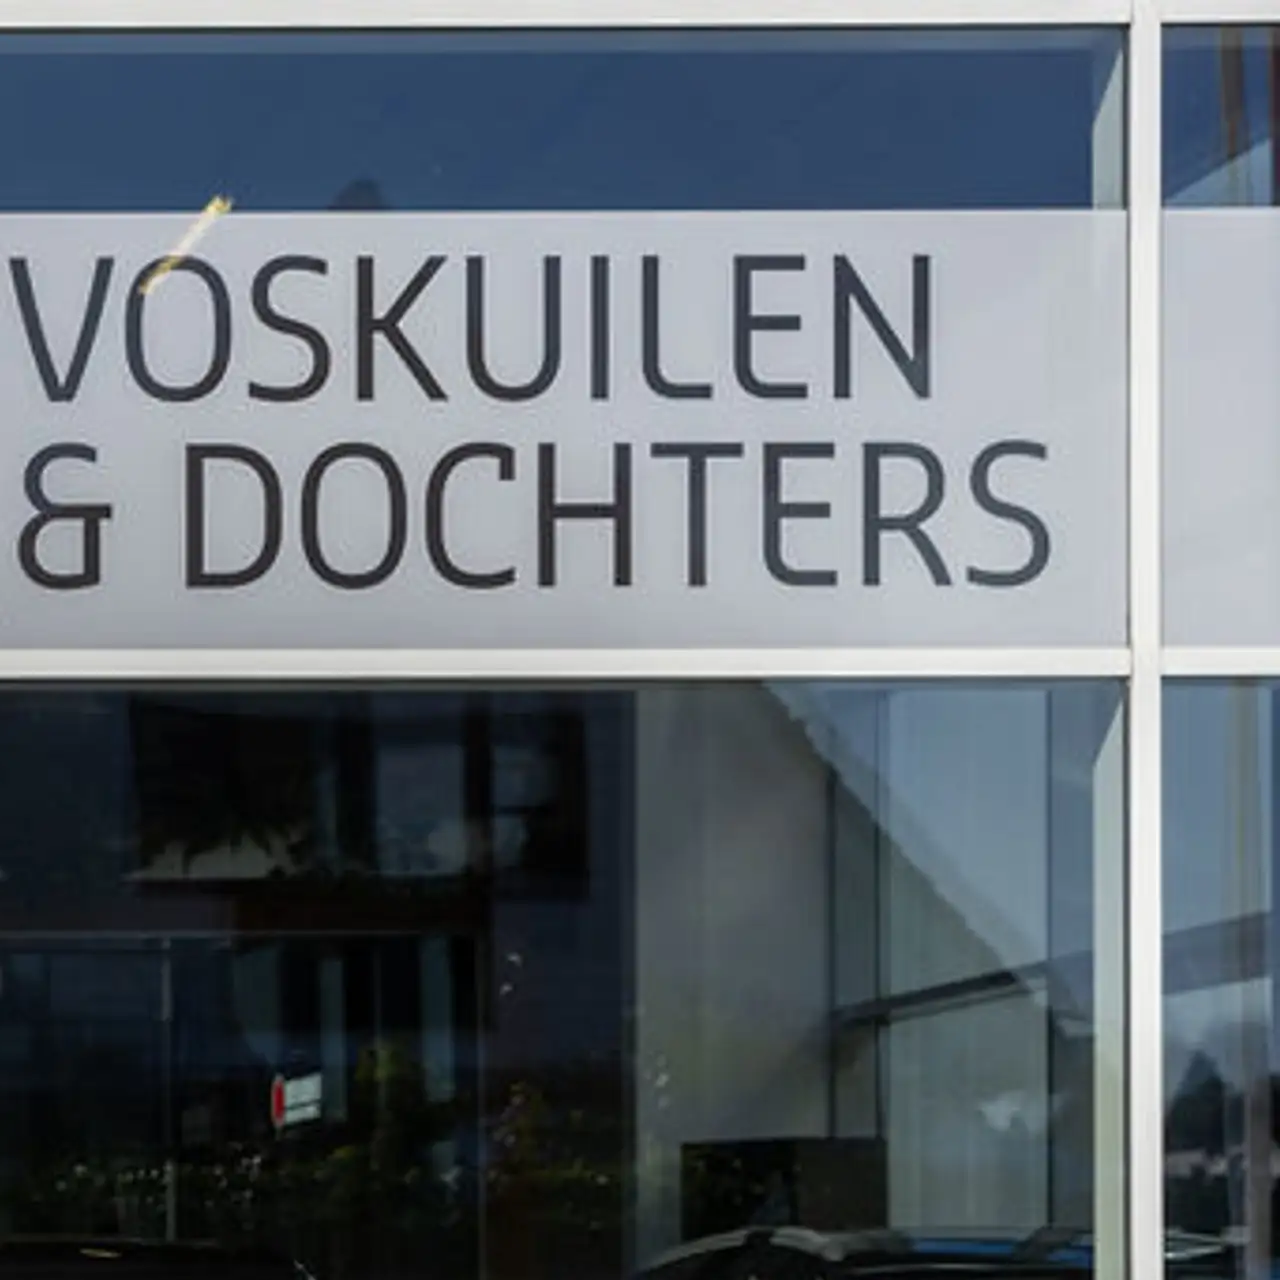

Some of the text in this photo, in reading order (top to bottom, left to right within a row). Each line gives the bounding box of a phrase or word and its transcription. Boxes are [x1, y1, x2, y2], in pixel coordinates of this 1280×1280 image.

[9, 254, 932, 401] VOSKUILEN
[17, 440, 1051, 590] & DOCHTERS
